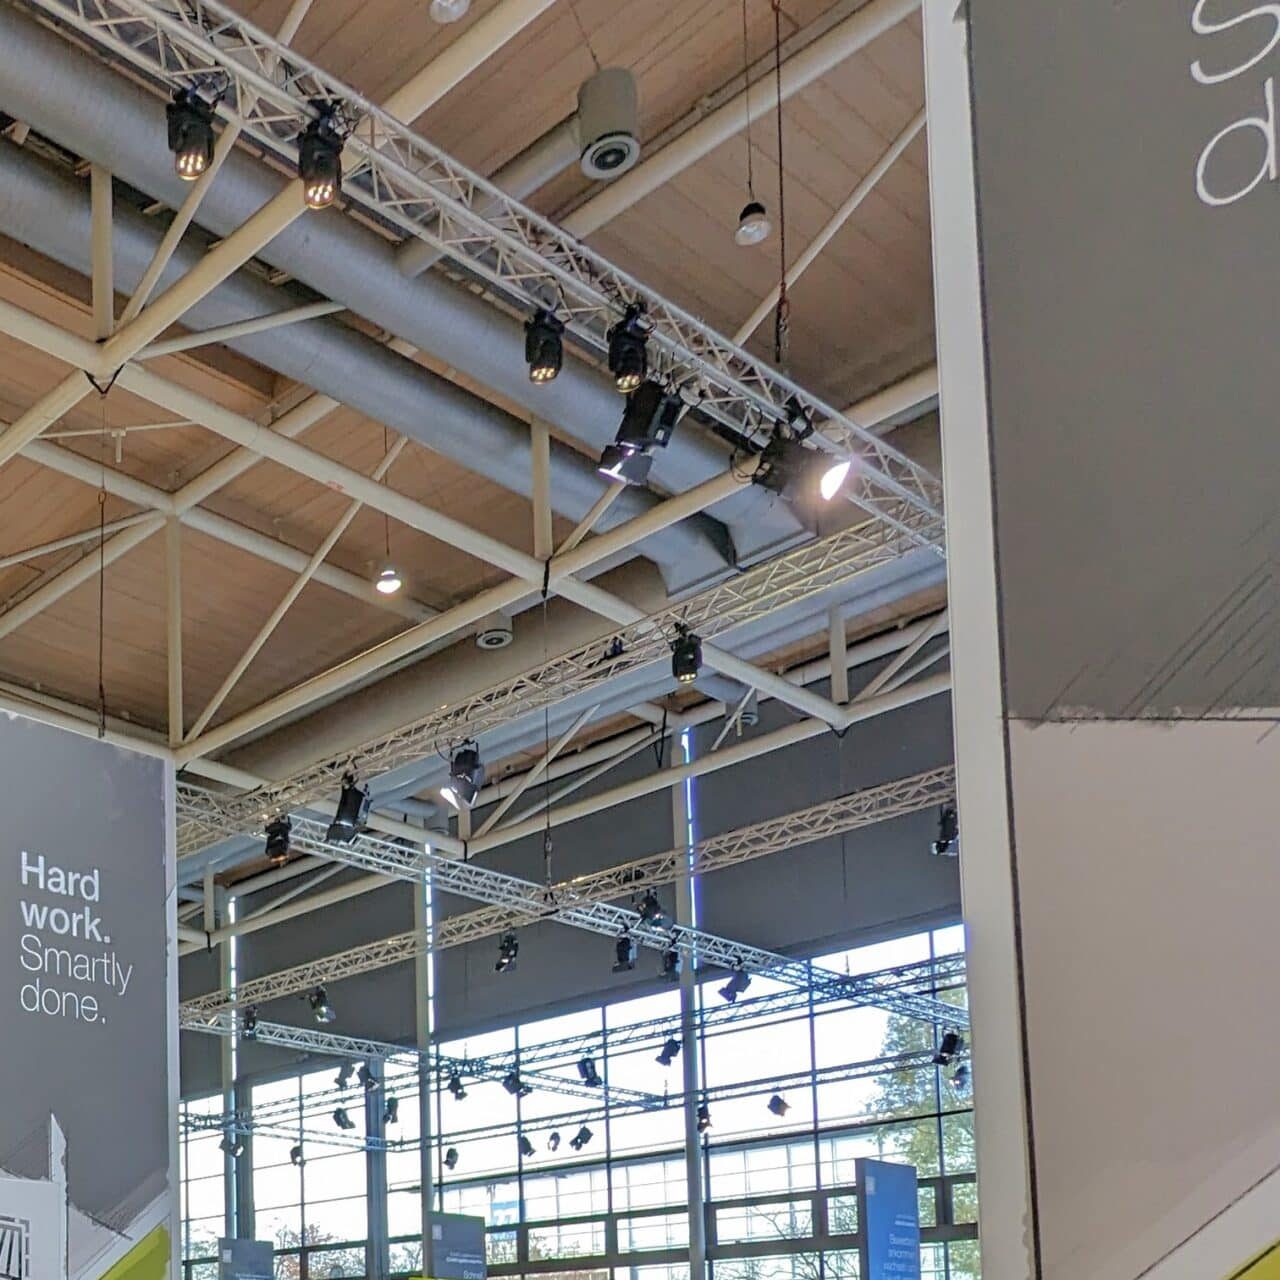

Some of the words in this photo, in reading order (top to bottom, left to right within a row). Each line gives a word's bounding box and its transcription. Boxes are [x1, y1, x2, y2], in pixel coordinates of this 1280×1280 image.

[20, 851, 100, 902] Hard
[20, 900, 110, 944] work.
[20, 934, 133, 996] Smartly
[20, 978, 107, 1024] done.
